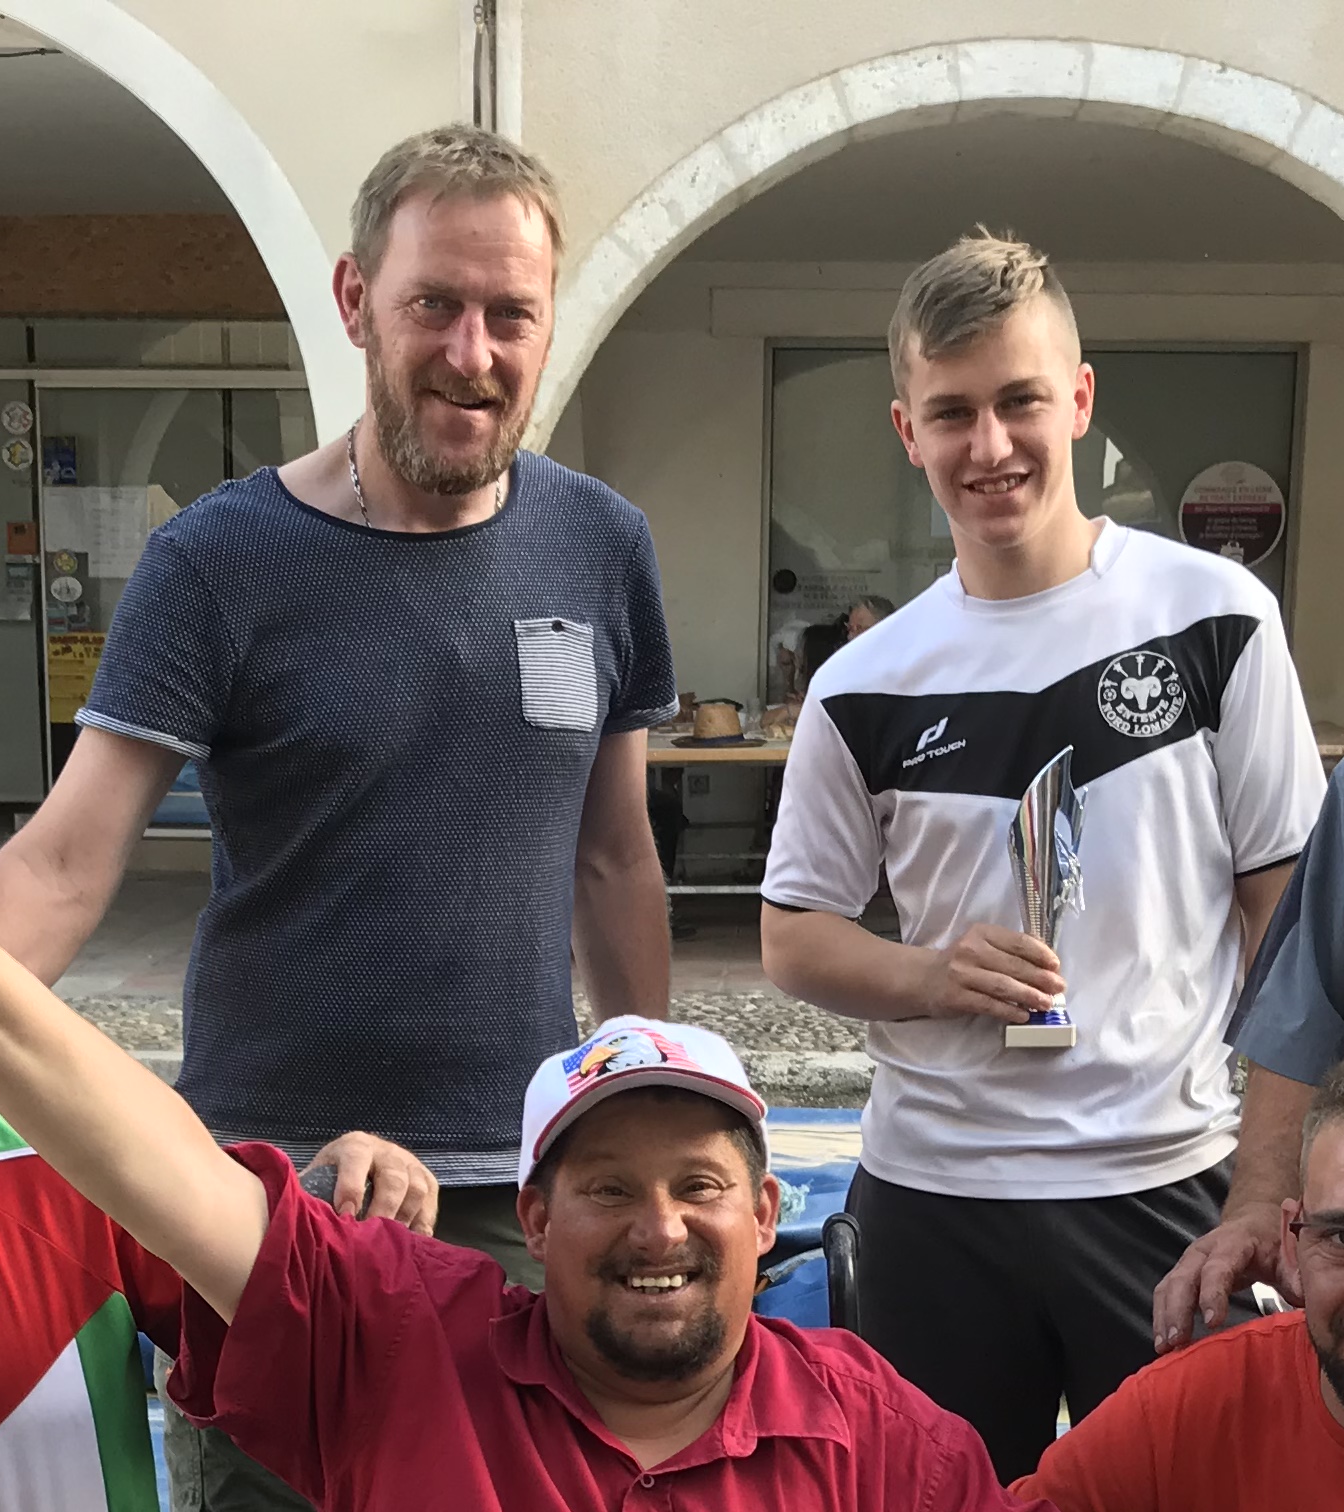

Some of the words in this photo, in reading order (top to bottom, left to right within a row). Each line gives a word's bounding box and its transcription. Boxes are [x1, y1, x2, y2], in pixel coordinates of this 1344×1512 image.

[1101, 702, 1131, 733] NORD
[1134, 697, 1182, 734] LOMAGNE
[1116, 699, 1169, 722] ENTENTE
[902, 753, 926, 769] PRO
[926, 738, 967, 759] TOUCH
